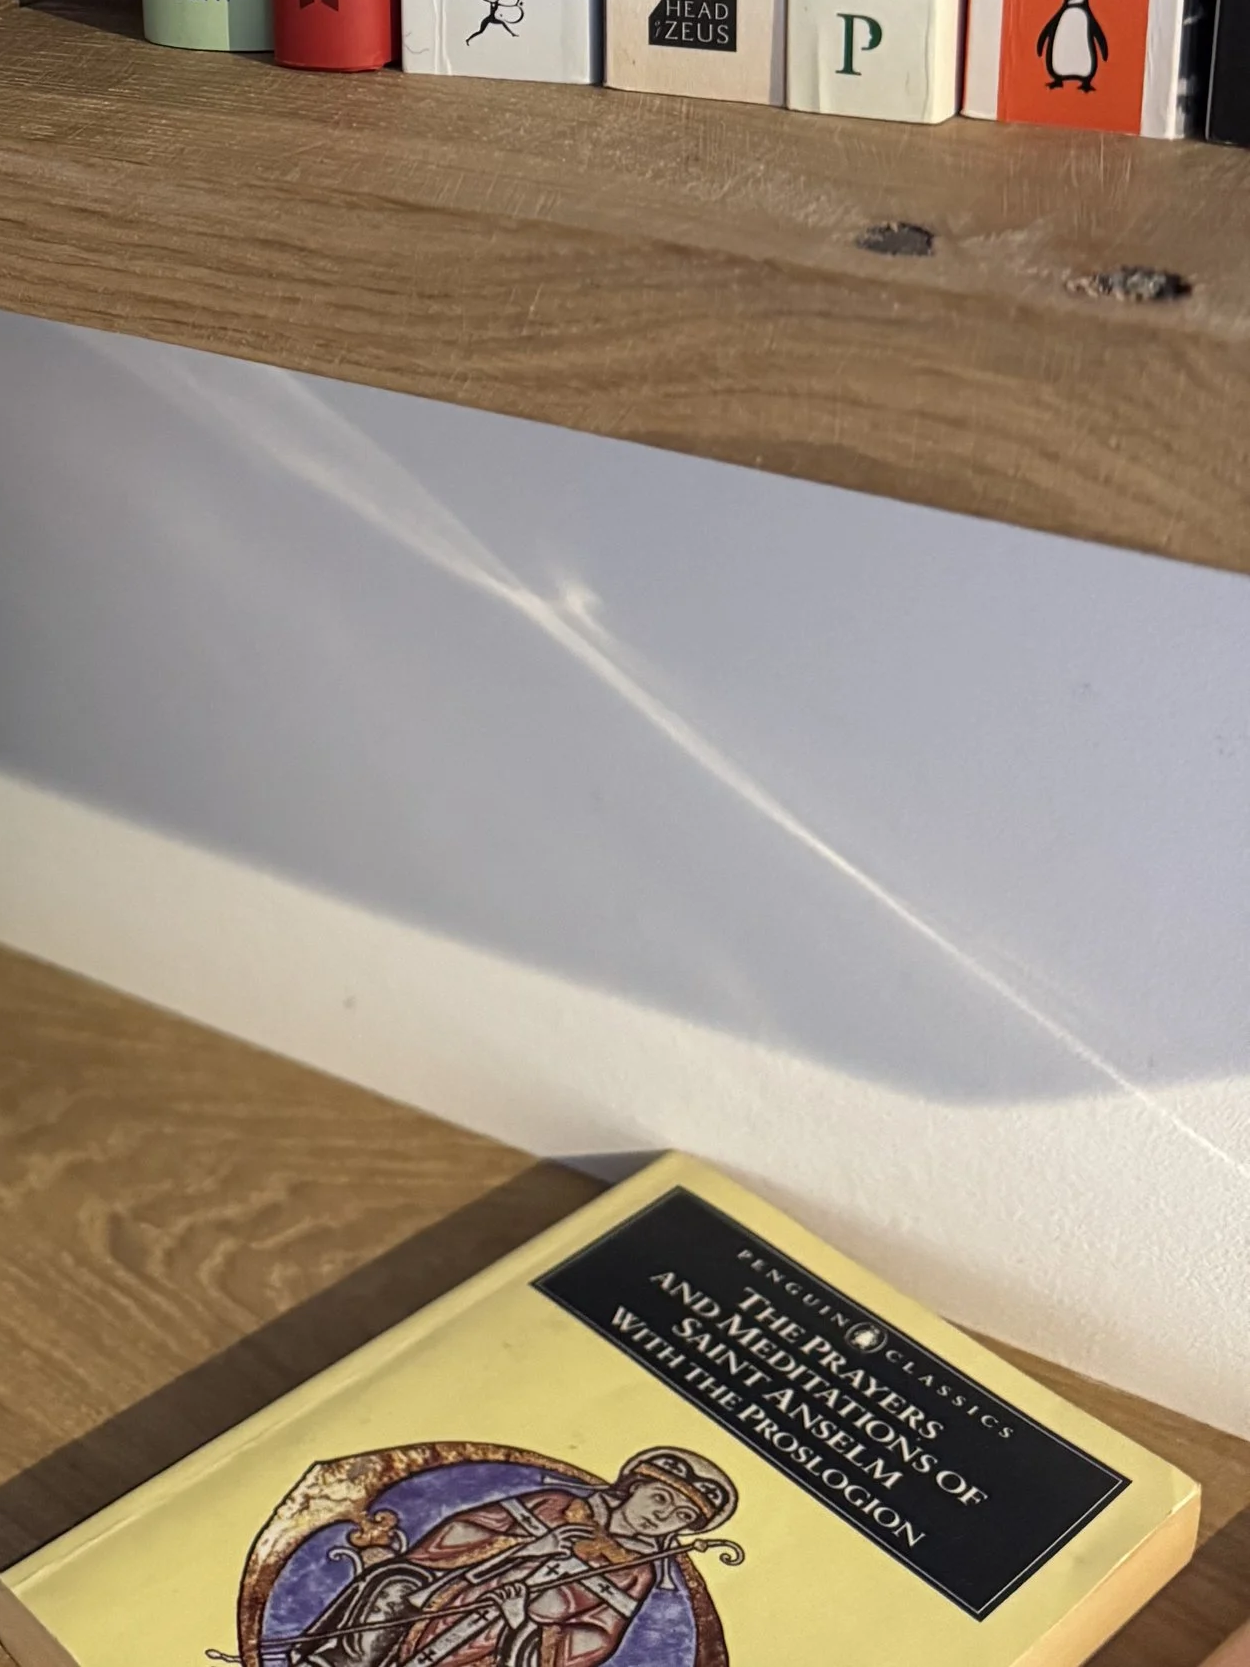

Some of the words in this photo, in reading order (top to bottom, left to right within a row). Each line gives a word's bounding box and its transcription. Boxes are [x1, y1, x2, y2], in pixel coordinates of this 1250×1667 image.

[664, 20, 730, 45] ZEUS
[835, 12, 884, 77] P
[610, 1304, 687, 1370] WITH
[682, 1361, 744, 1412] THE
[736, 1403, 927, 1548] PROSLOGION
[649, 1270, 721, 1319] AND
[717, 1312, 939, 1474] MEDITATIONS
[935, 1469, 989, 1507] OF
[671, 1316, 773, 1388] SAINT
[762, 1387, 904, 1491] ANSELM
[736, 1248, 850, 1328] PENGUIN
[885, 1348, 1014, 1440] CLASSICS
[738, 1286, 807, 1344] THE
[800, 1334, 945, 1440] PRAYERS
